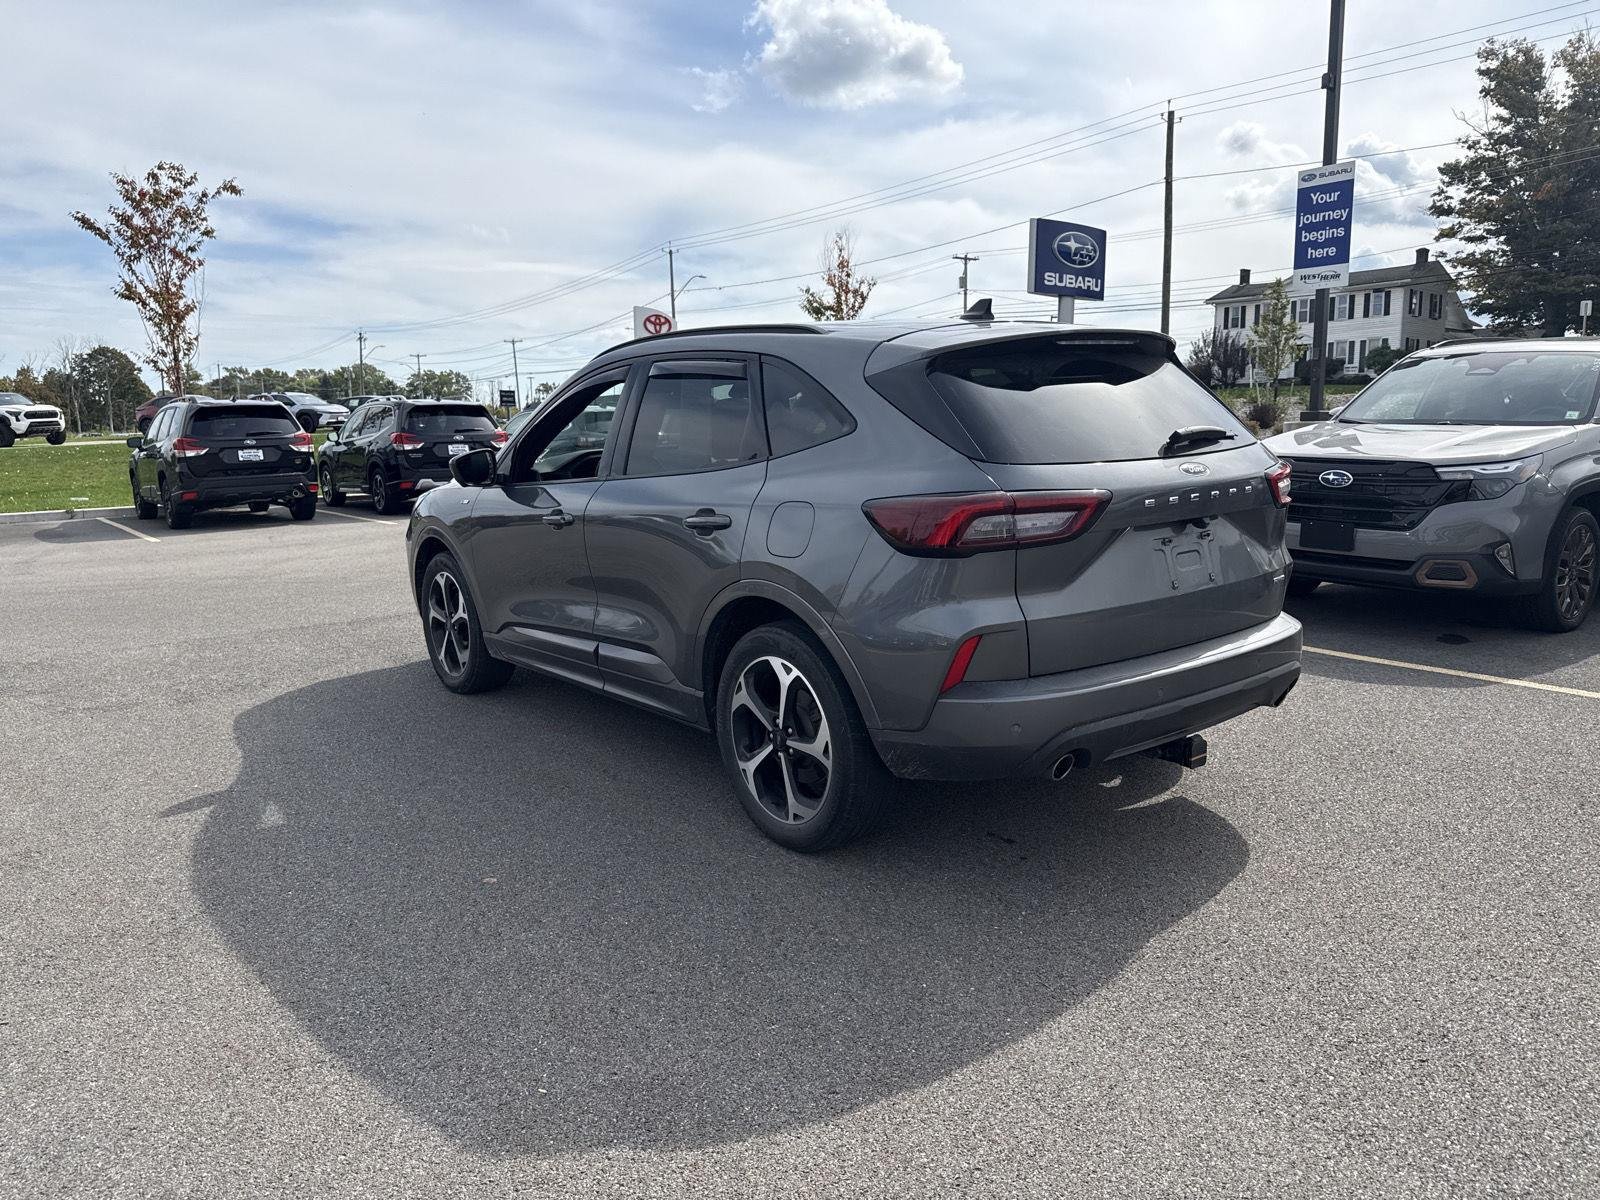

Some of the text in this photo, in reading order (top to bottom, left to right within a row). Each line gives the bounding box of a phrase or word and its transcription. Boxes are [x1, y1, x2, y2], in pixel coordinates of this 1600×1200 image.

[1318, 168, 1353, 179] SUBARU
[1310, 191, 1341, 205] Your
[1298, 208, 1350, 227] journey
[1301, 226, 1345, 242] begins
[1307, 246, 1337, 259] here
[1044, 272, 1101, 292] SUBARU
